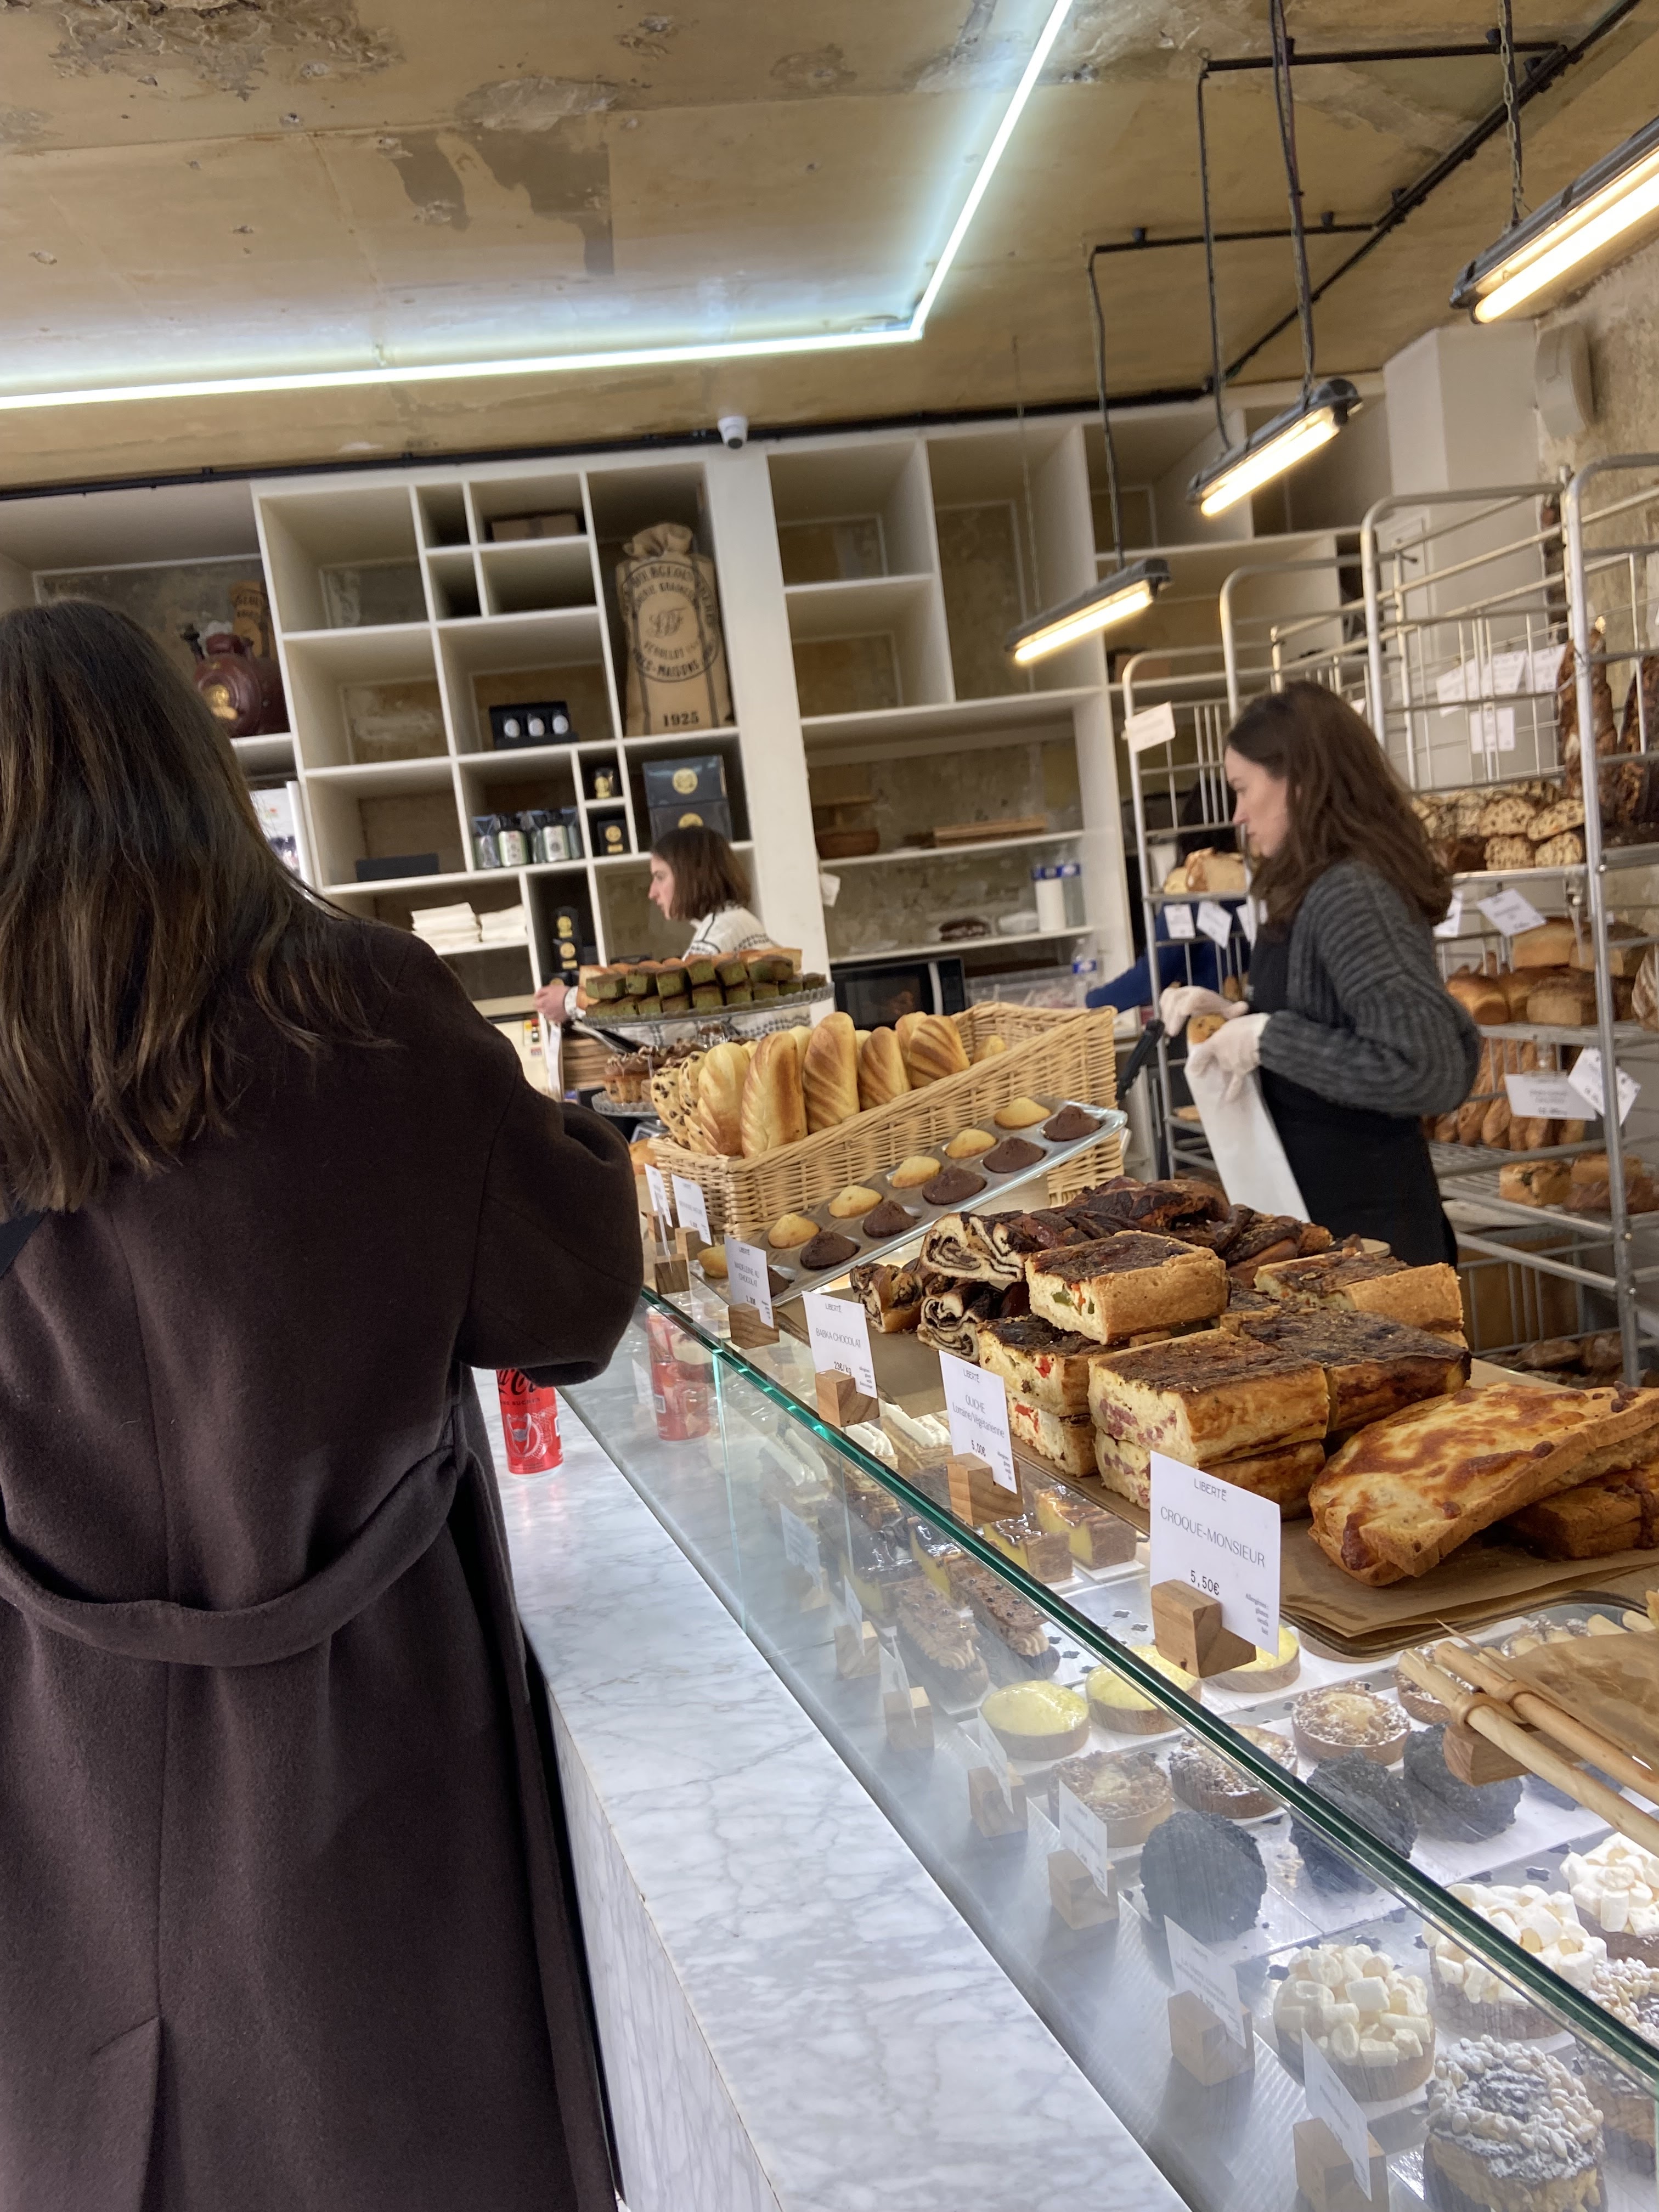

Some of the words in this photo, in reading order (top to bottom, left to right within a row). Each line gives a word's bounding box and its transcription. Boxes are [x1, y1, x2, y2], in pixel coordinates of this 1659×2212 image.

[663, 710, 700, 727] 1925
[816, 1328, 833, 1341] BABKA
[833, 1332, 861, 1348] CHOCOLAT
[966, 1395, 986, 1414] QUICHE
[1194, 1479, 1227, 1502] LIBERTÉ
[1160, 1506, 1266, 1568] CROQUE-MONSIEUR
[1190, 1569, 1220, 1595] 5,50€
